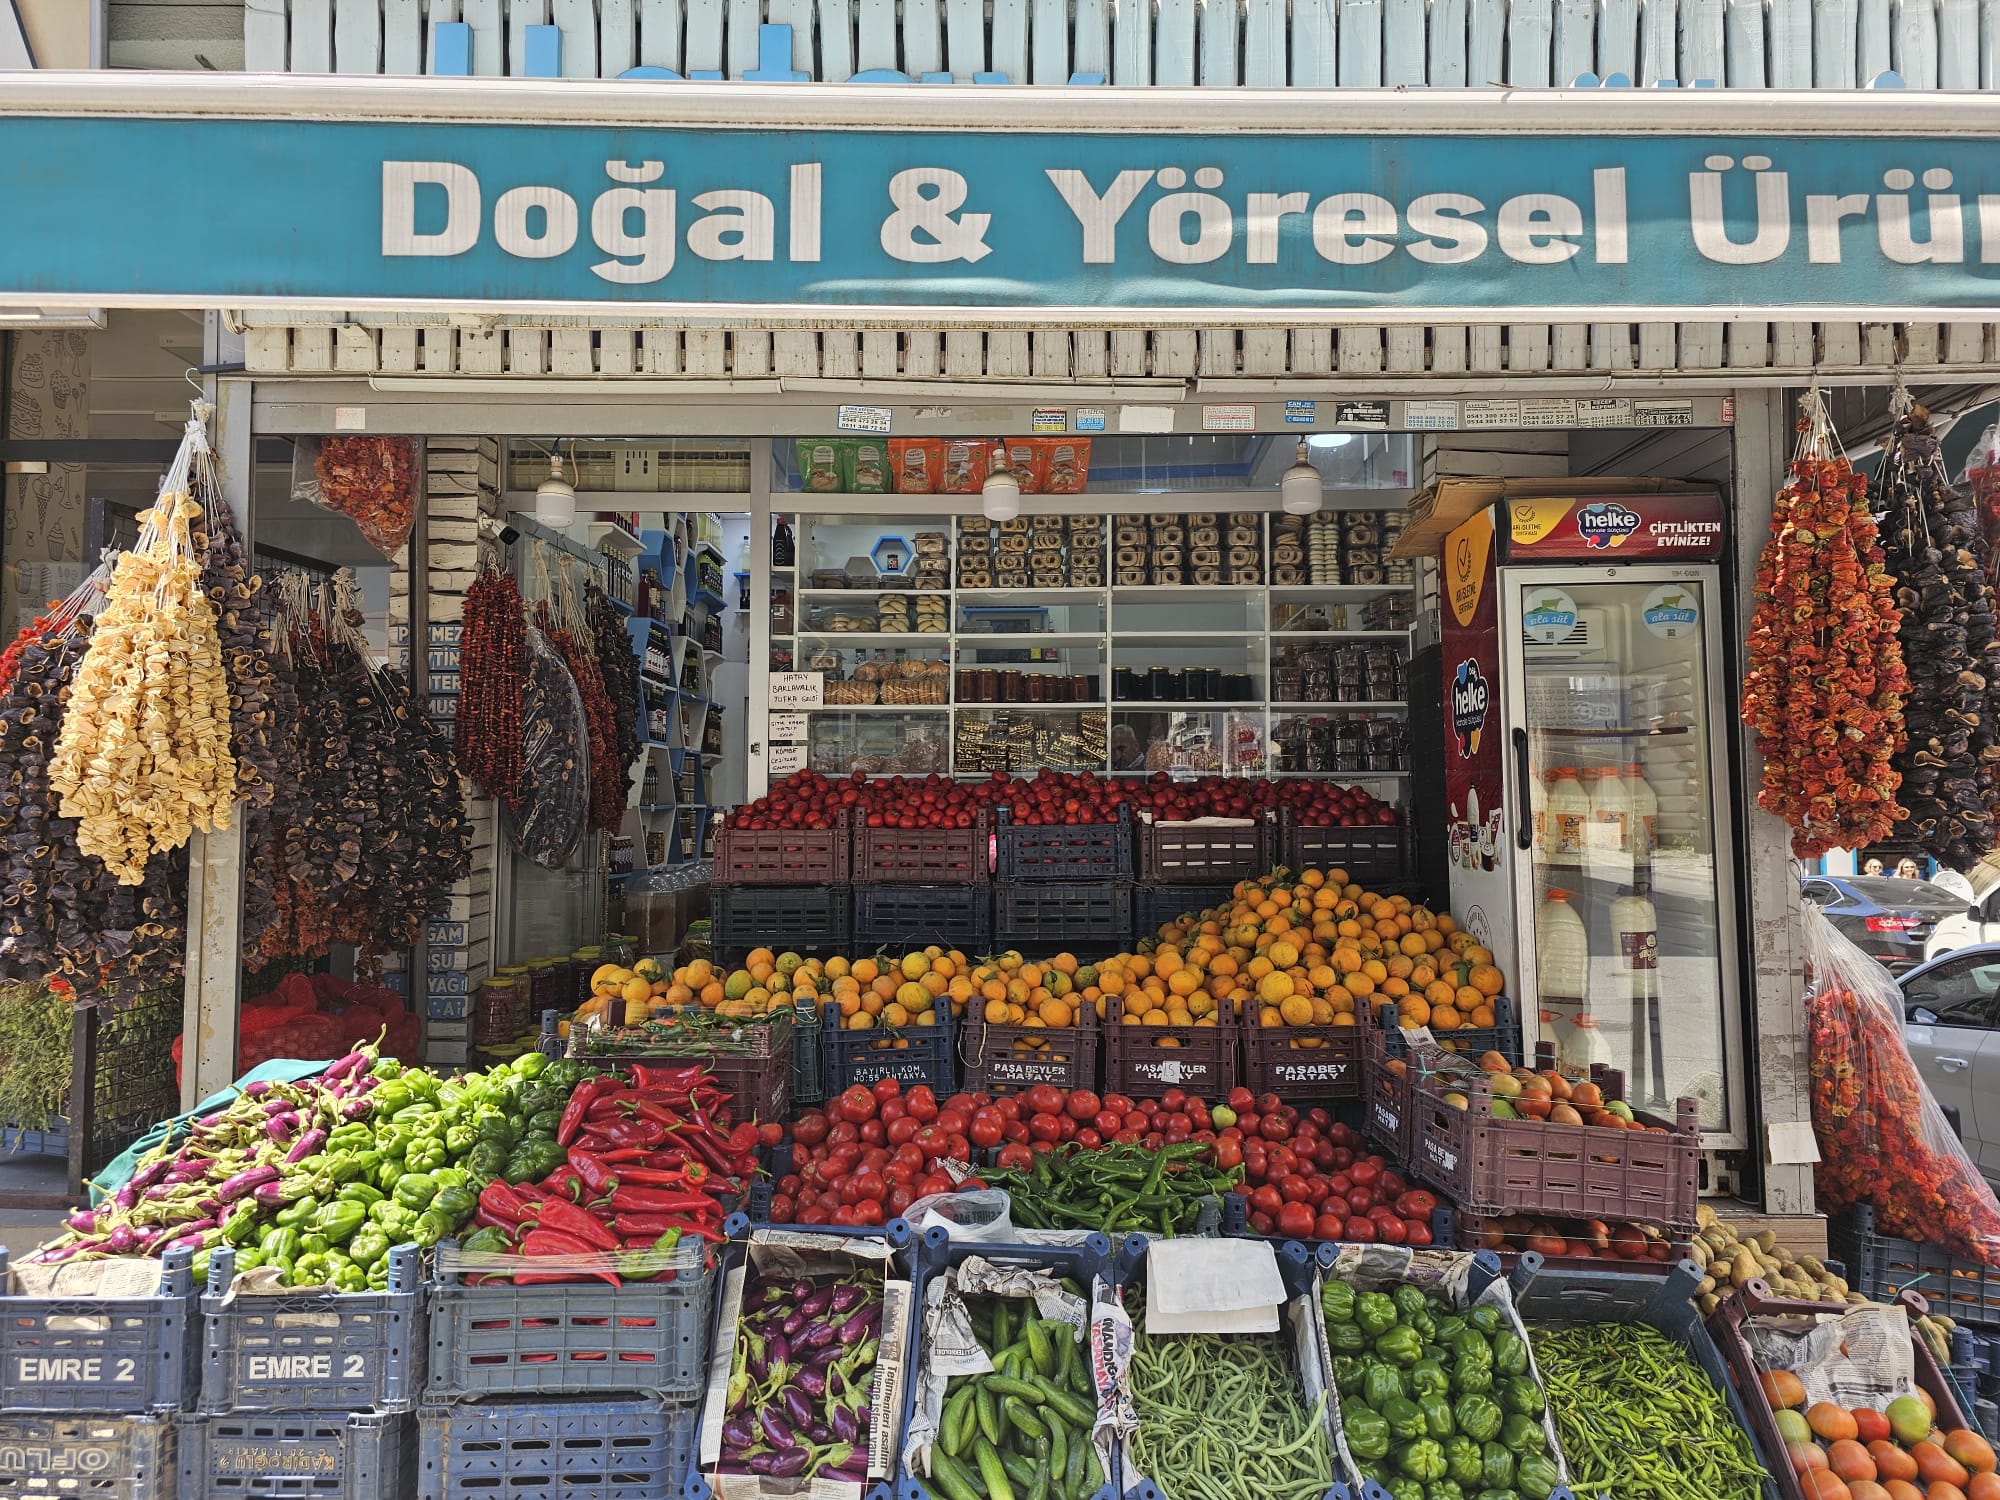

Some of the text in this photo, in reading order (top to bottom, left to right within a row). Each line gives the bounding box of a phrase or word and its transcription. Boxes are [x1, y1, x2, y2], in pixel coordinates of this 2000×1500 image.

[382, 155, 2000, 284] Doğal & Yöresel Ürü
[1585, 512, 1635, 527] helke
[1649, 520, 1721, 536] ÇİFTLİKTEN
[1657, 534, 1710, 547] EVİNİZE!
[1551, 614, 1568, 625] süt
[1651, 613, 1689, 622] ala süt
[1456, 683, 1486, 715] helke
[994, 1064, 1022, 1075] PAŞA
[1275, 1064, 1348, 1075] PAŞABEY
[1285, 1072, 1339, 1081] HATAY
[20, 1358, 135, 1381] EMRE 2
[249, 1354, 364, 1379] EMRE 2
[882, 1366, 898, 1428] Teğmenleri
